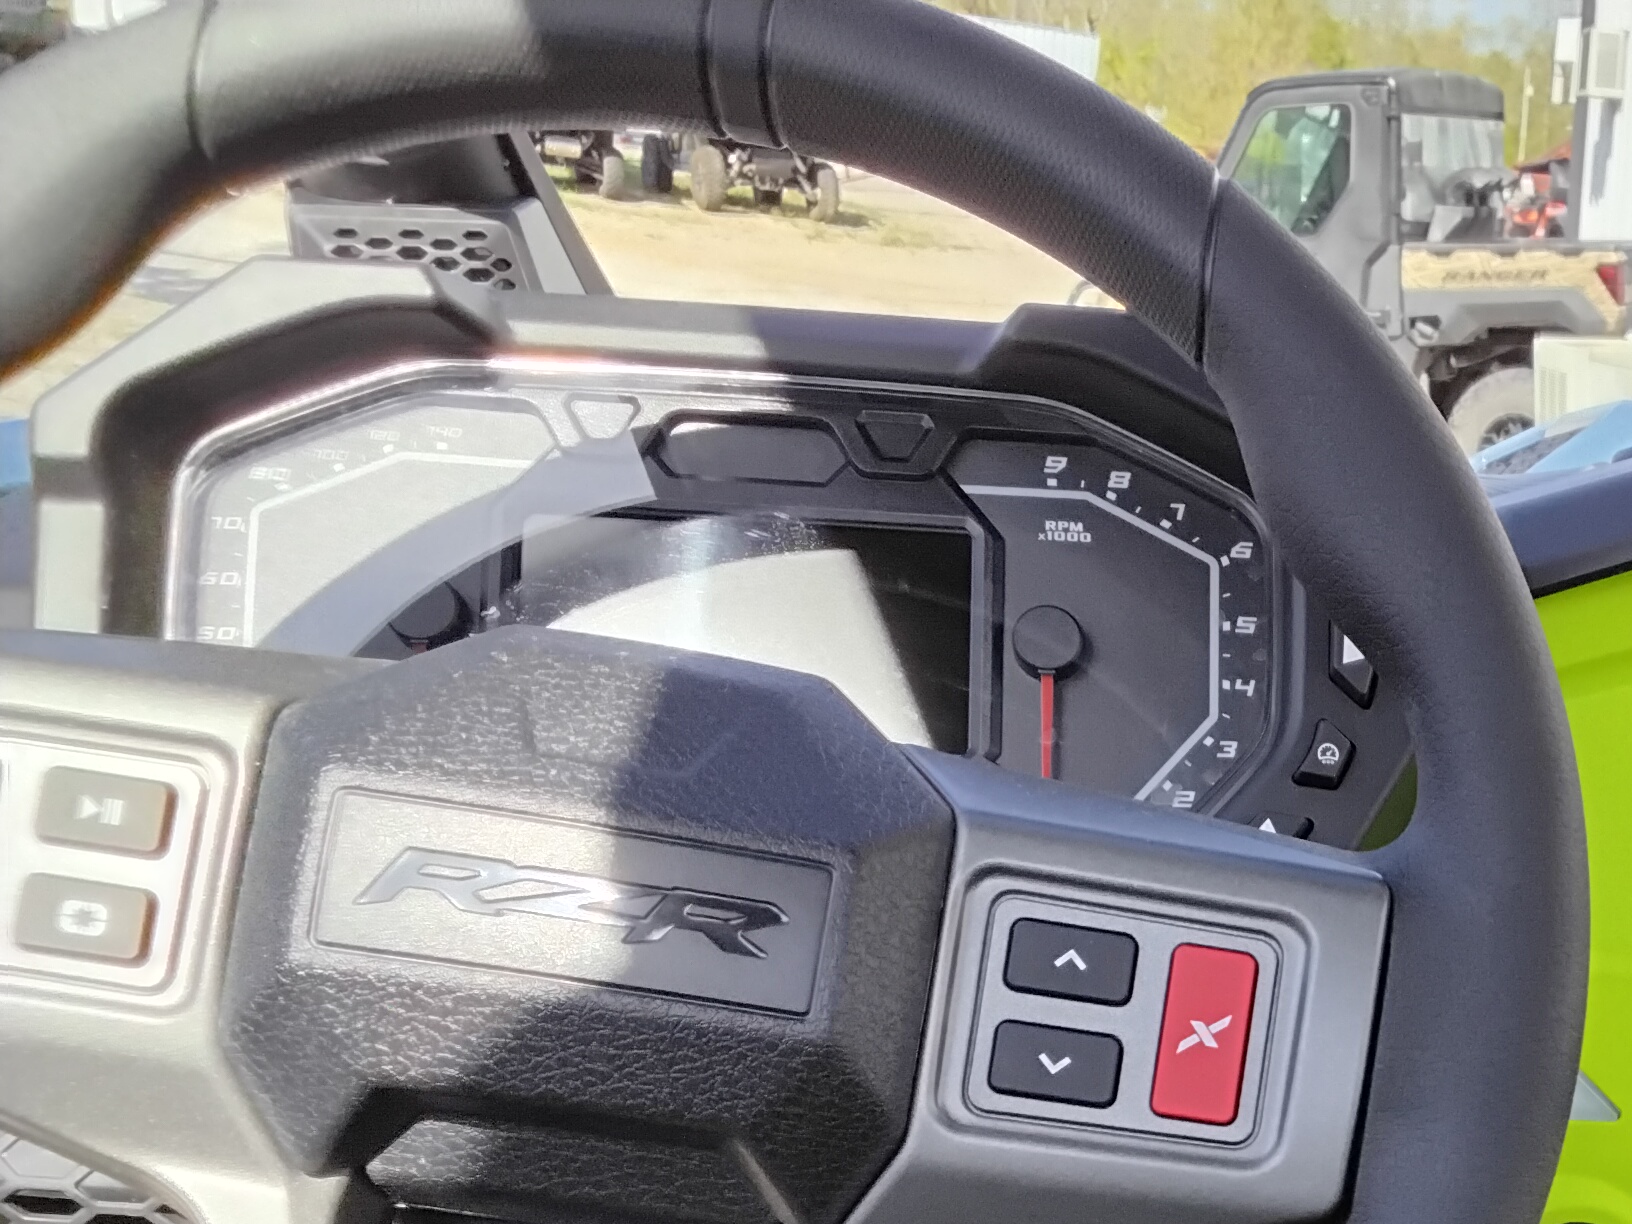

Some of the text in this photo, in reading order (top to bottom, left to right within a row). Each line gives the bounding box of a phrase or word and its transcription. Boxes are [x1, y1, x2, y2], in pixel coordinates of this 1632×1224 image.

[429, 426, 463, 439] 140
[1044, 456, 1068, 474] 9
[1107, 471, 1132, 489] 8
[1169, 503, 1186, 521] 7
[211, 516, 242, 530] 70
[1045, 520, 1084, 532] RPM
[1038, 530, 1091, 543] x1000
[1229, 542, 1254, 559] 6
[200, 572, 239, 585] 60
[197, 626, 237, 640] 50
[1234, 616, 1258, 634] 5
[1234, 679, 1256, 698] 4
[1216, 740, 1238, 759] 3
[1171, 790, 1196, 809] 2
